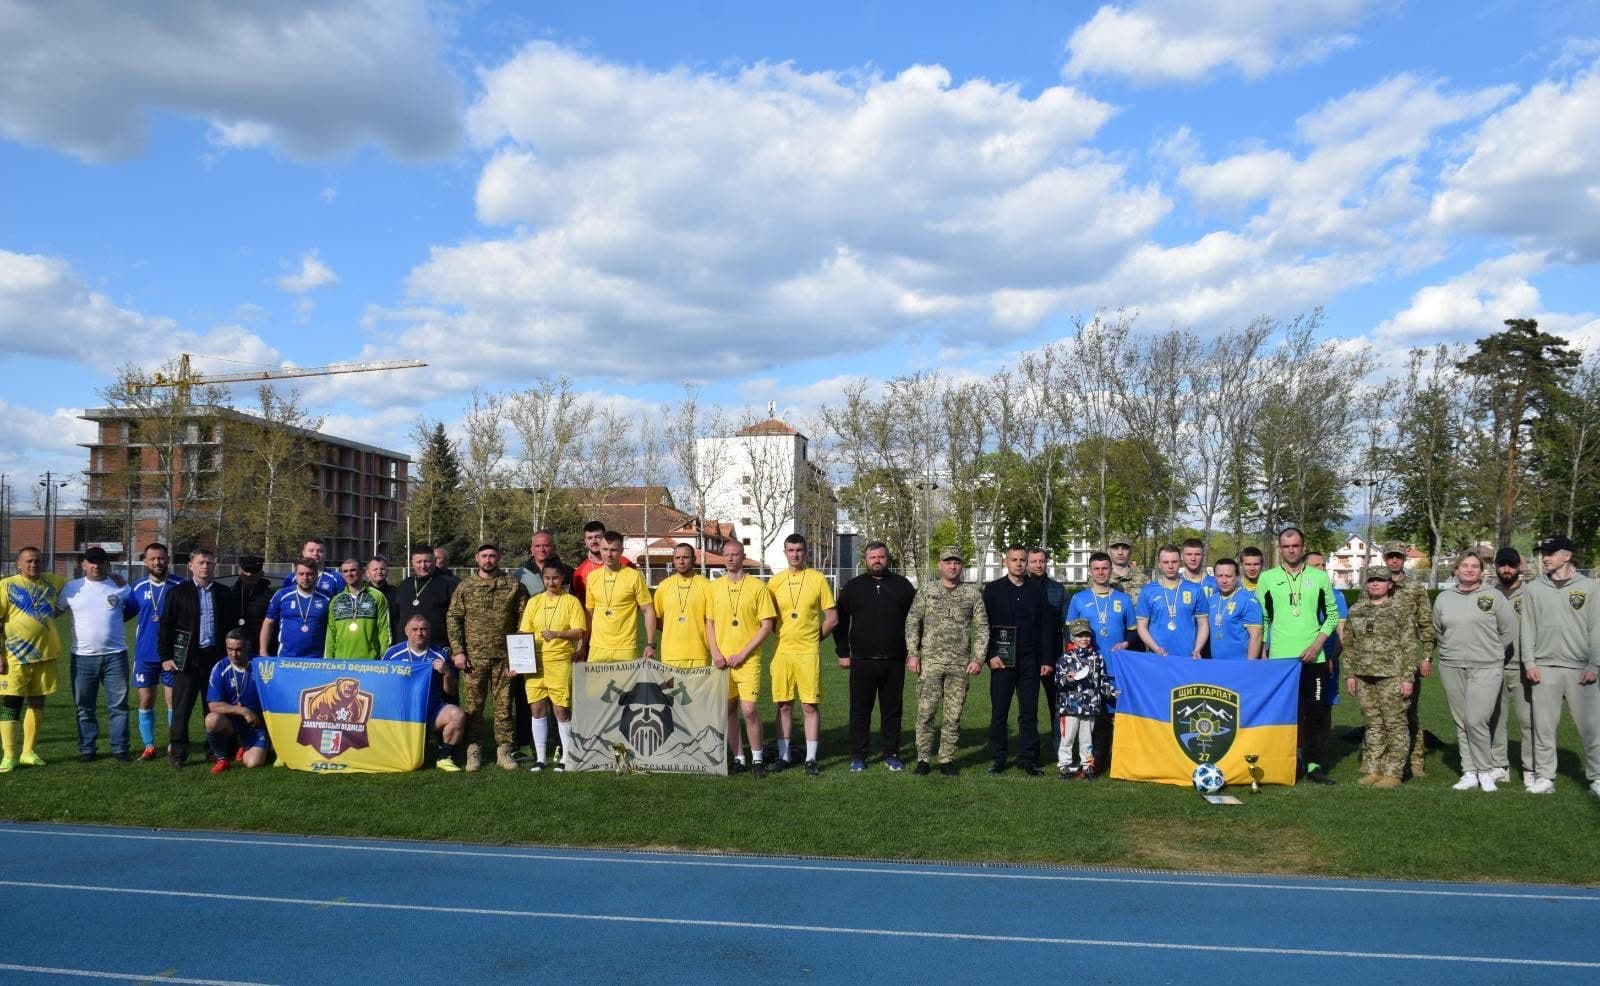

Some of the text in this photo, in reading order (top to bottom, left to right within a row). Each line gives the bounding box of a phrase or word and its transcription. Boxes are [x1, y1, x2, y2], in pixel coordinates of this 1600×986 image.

[1182, 590, 1192, 605] 8
[1113, 599, 1122, 613] 6
[1227, 602, 1237, 615] 4
[279, 659, 412, 676] Закарпатські ведмеді УБД
[584, 662, 640, 674] НАЦІОНАЛЬНА
[135, 673, 145, 683] 14
[1178, 687, 1233, 700] ЩИТ КАРПАТ
[341, 723, 365, 732] ВЕДМЕДІ
[1198, 752, 1210, 762] 27
